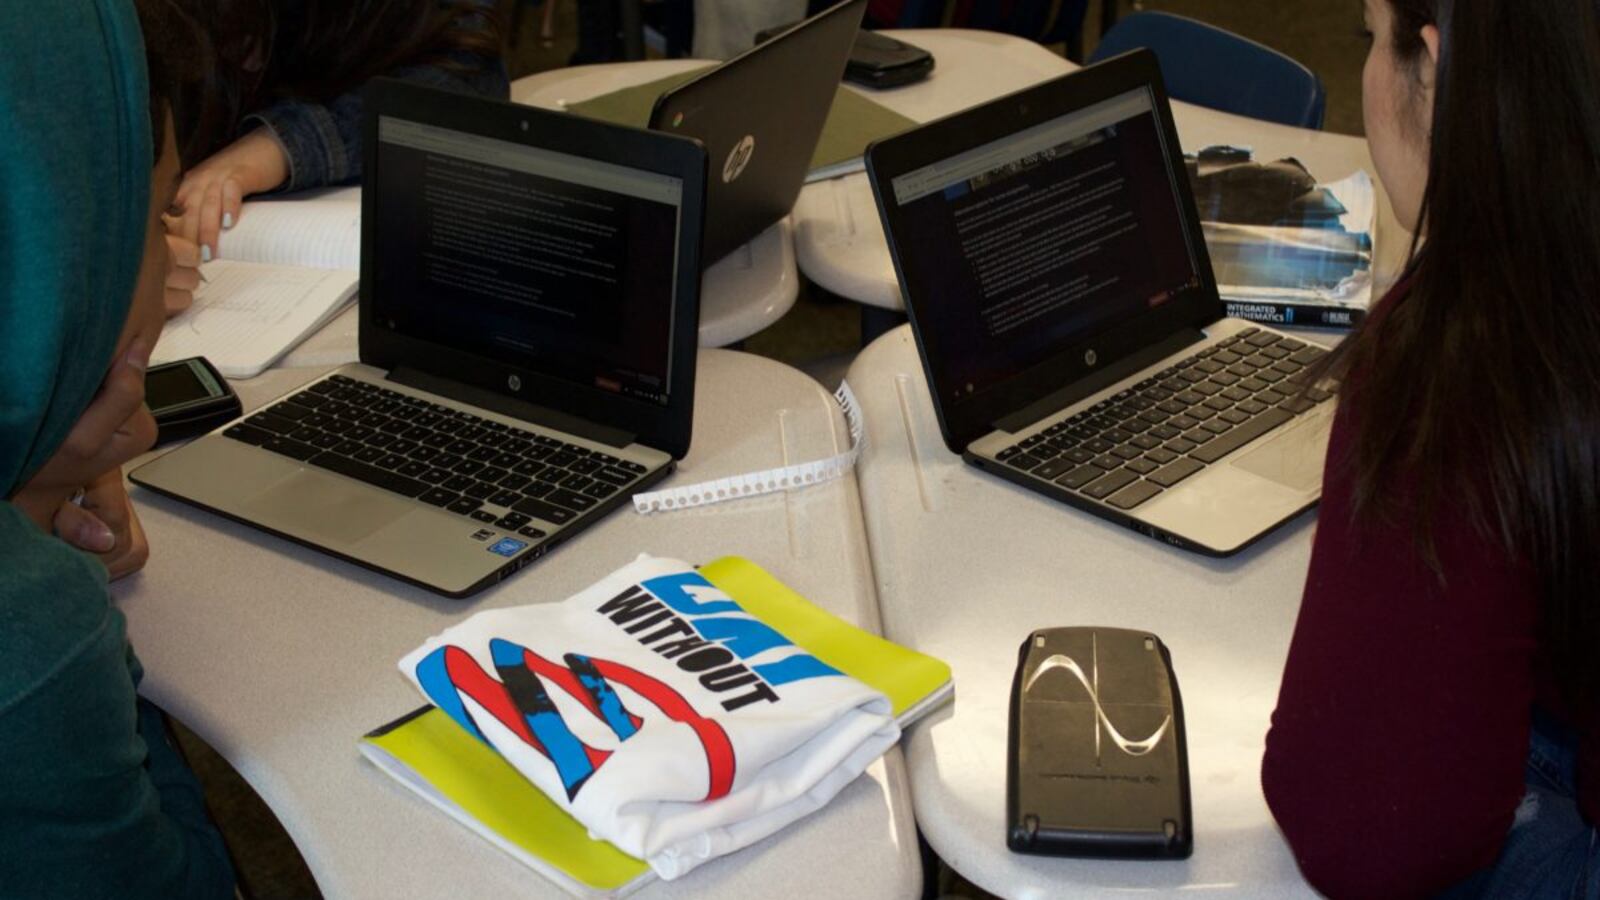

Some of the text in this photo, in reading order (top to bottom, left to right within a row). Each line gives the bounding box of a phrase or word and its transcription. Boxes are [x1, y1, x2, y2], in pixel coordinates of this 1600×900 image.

[1226, 303, 1276, 314] INTEGRATED
[1227, 311, 1285, 323] MATHEMATICS
[596, 584, 781, 712] WITHOUT
